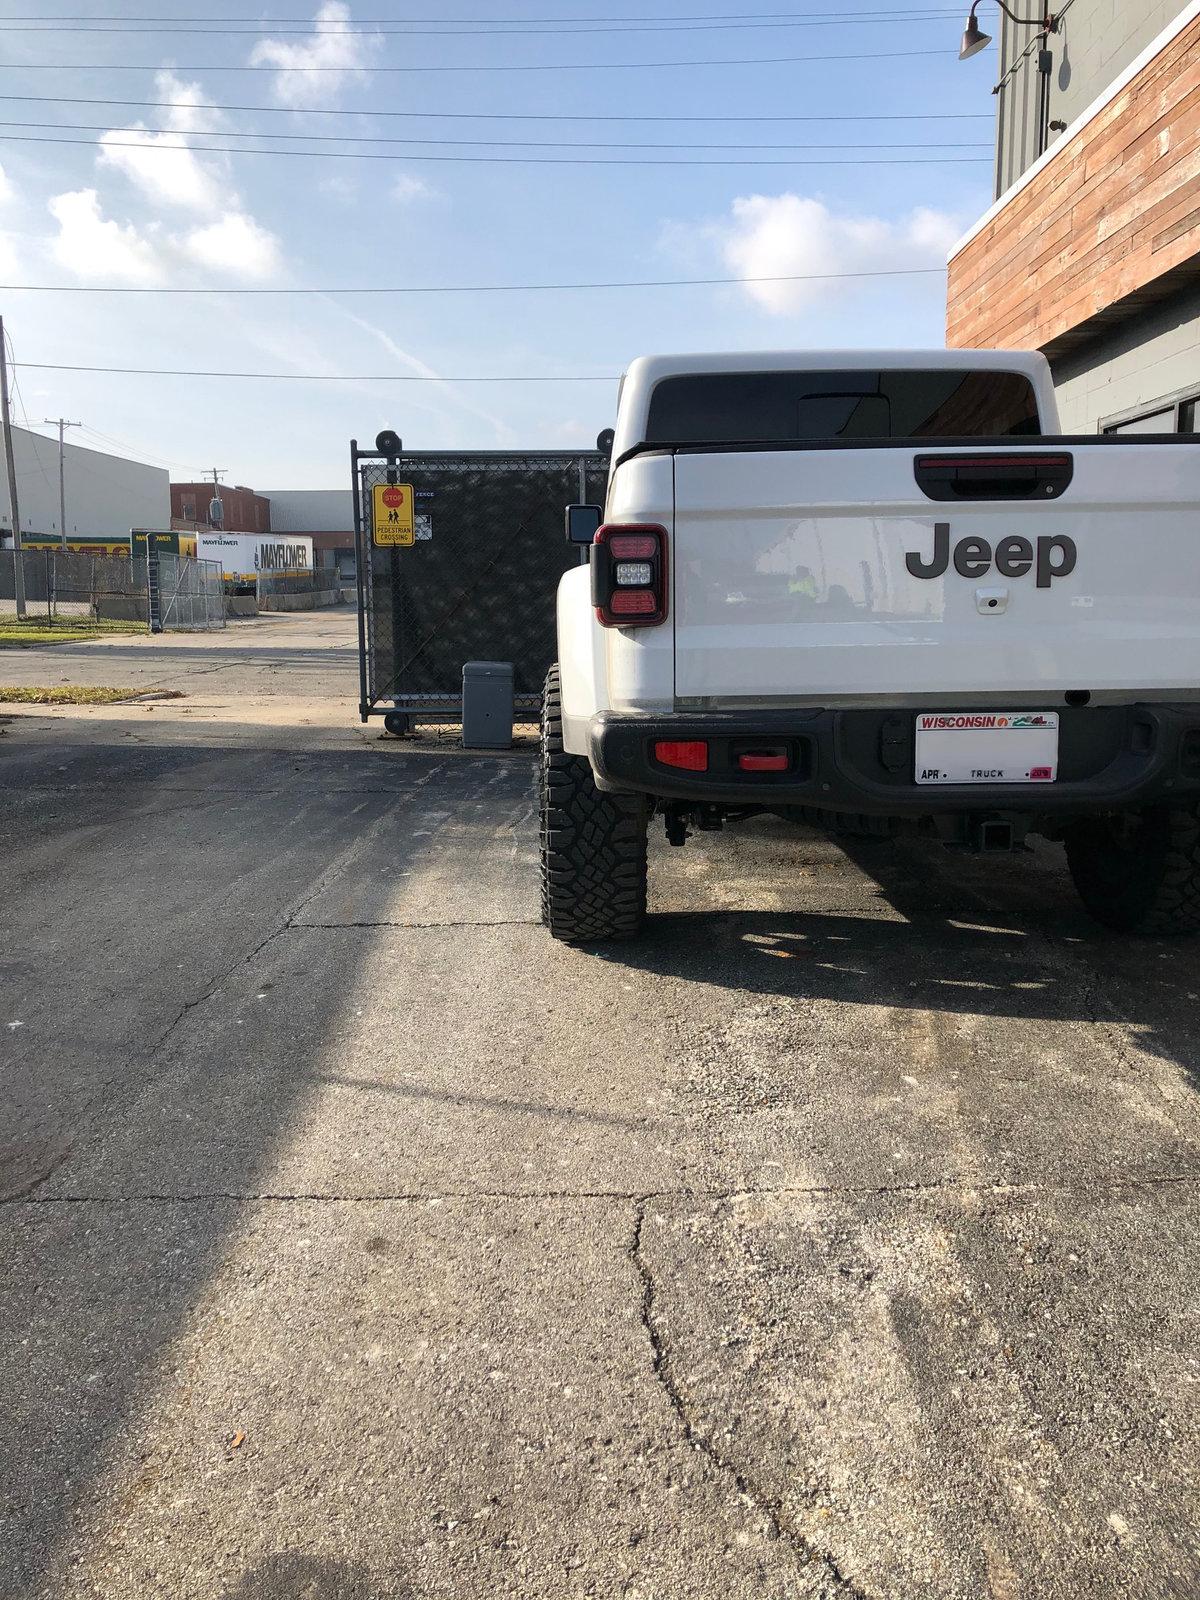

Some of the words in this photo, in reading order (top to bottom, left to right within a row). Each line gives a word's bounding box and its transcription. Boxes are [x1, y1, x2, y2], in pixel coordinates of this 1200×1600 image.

[260, 544, 307, 568] MAYFLOWER
[905, 522, 1077, 588] Jeep
[922, 716, 996, 728] WISCONSIN
[921, 769, 940, 779] APR
[971, 769, 1004, 777] TRUCK
